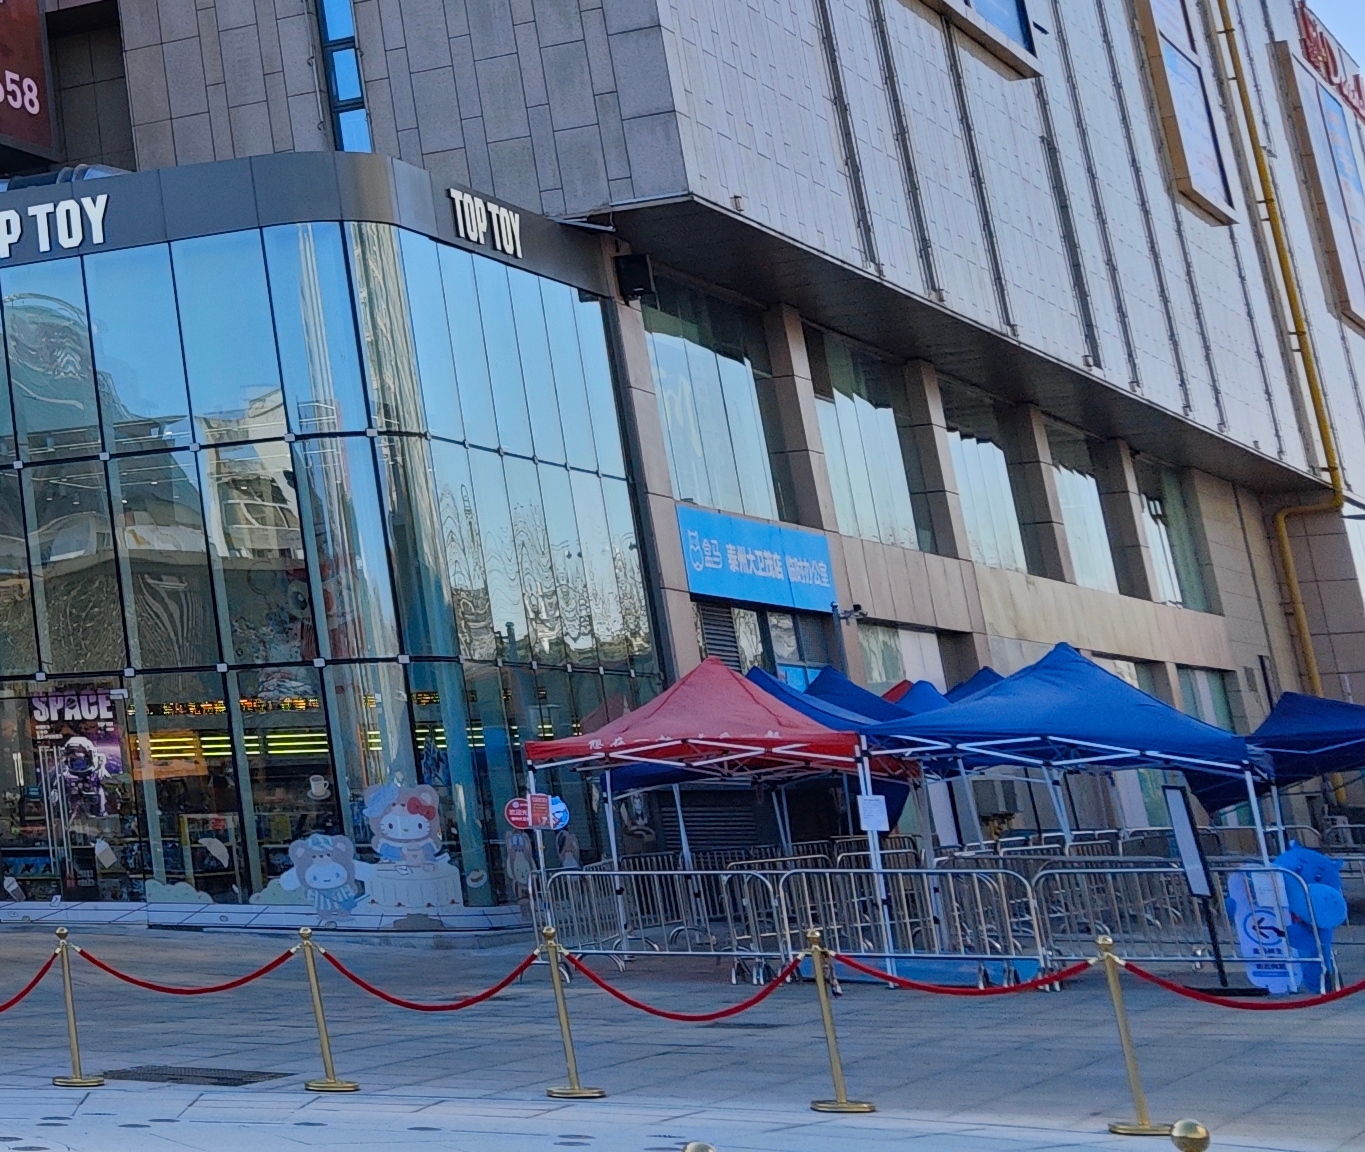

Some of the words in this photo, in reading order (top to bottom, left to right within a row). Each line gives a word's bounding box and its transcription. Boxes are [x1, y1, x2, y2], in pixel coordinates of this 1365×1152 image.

[27, 194, 110, 252] TOY
[449, 188, 489, 241] TOP
[488, 204, 523, 259] TOY
[702, 538, 723, 569] 盒马
[725, 543, 785, 581] 泰州大卫茂店
[785, 554, 831, 588] 临时办公室
[32, 688, 114, 722] SPACE
